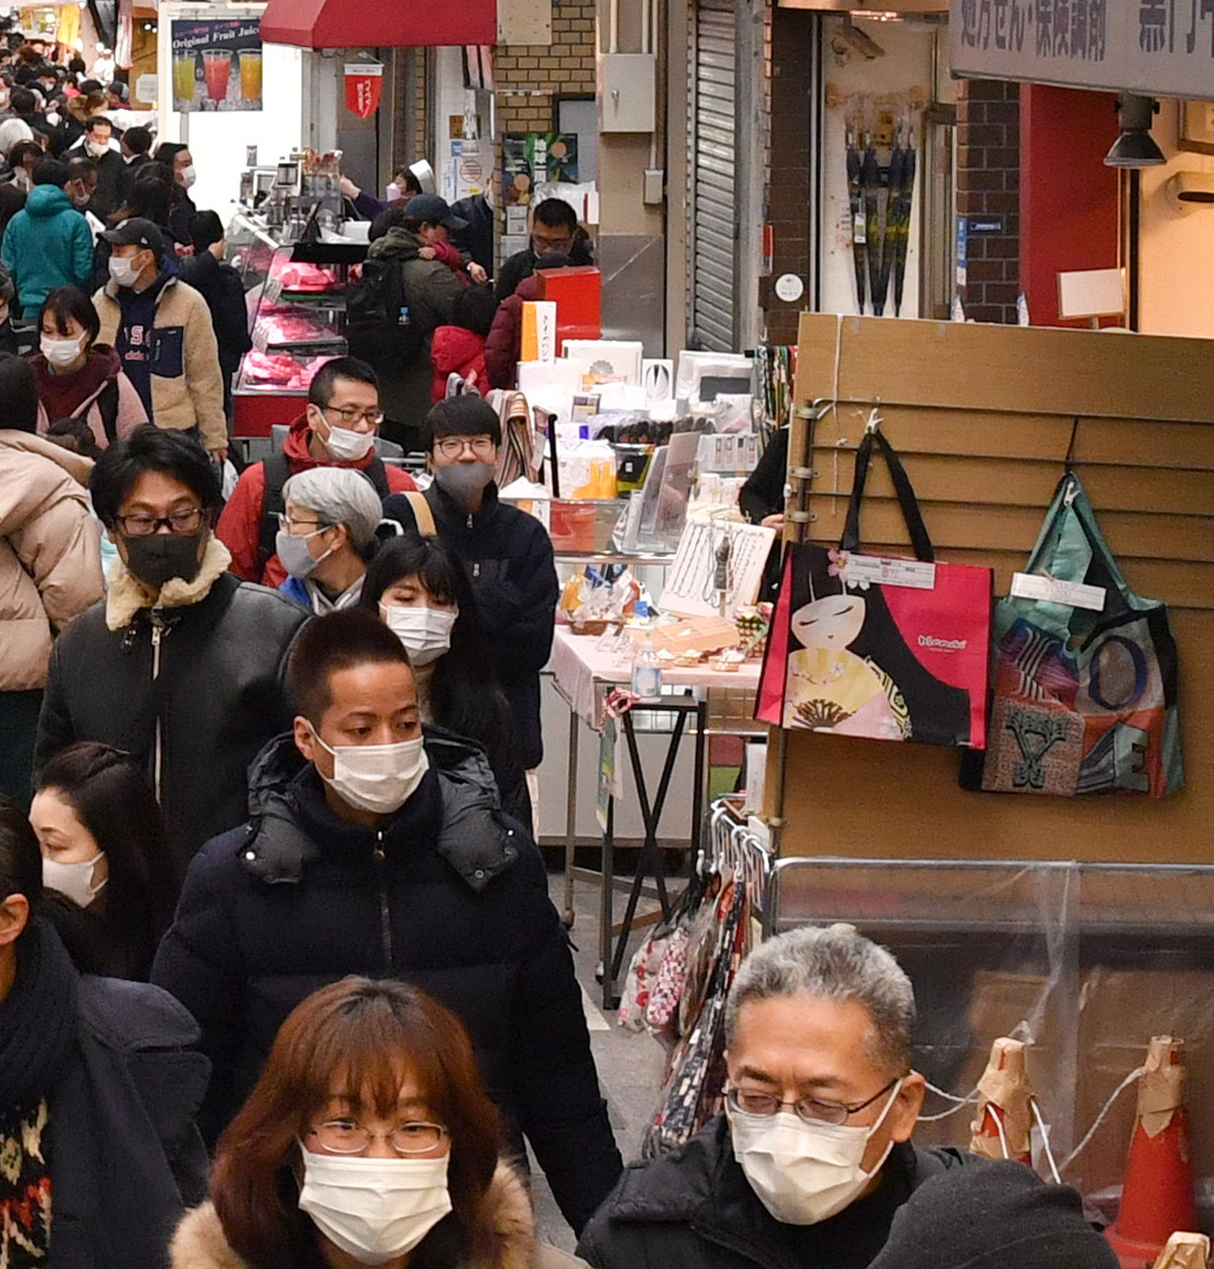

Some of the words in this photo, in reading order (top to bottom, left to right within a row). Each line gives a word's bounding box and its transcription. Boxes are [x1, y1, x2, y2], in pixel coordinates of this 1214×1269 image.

[173, 35, 210, 49] Original
[213, 30, 236, 42] Fruit
[238, 25, 260, 37] Juic
